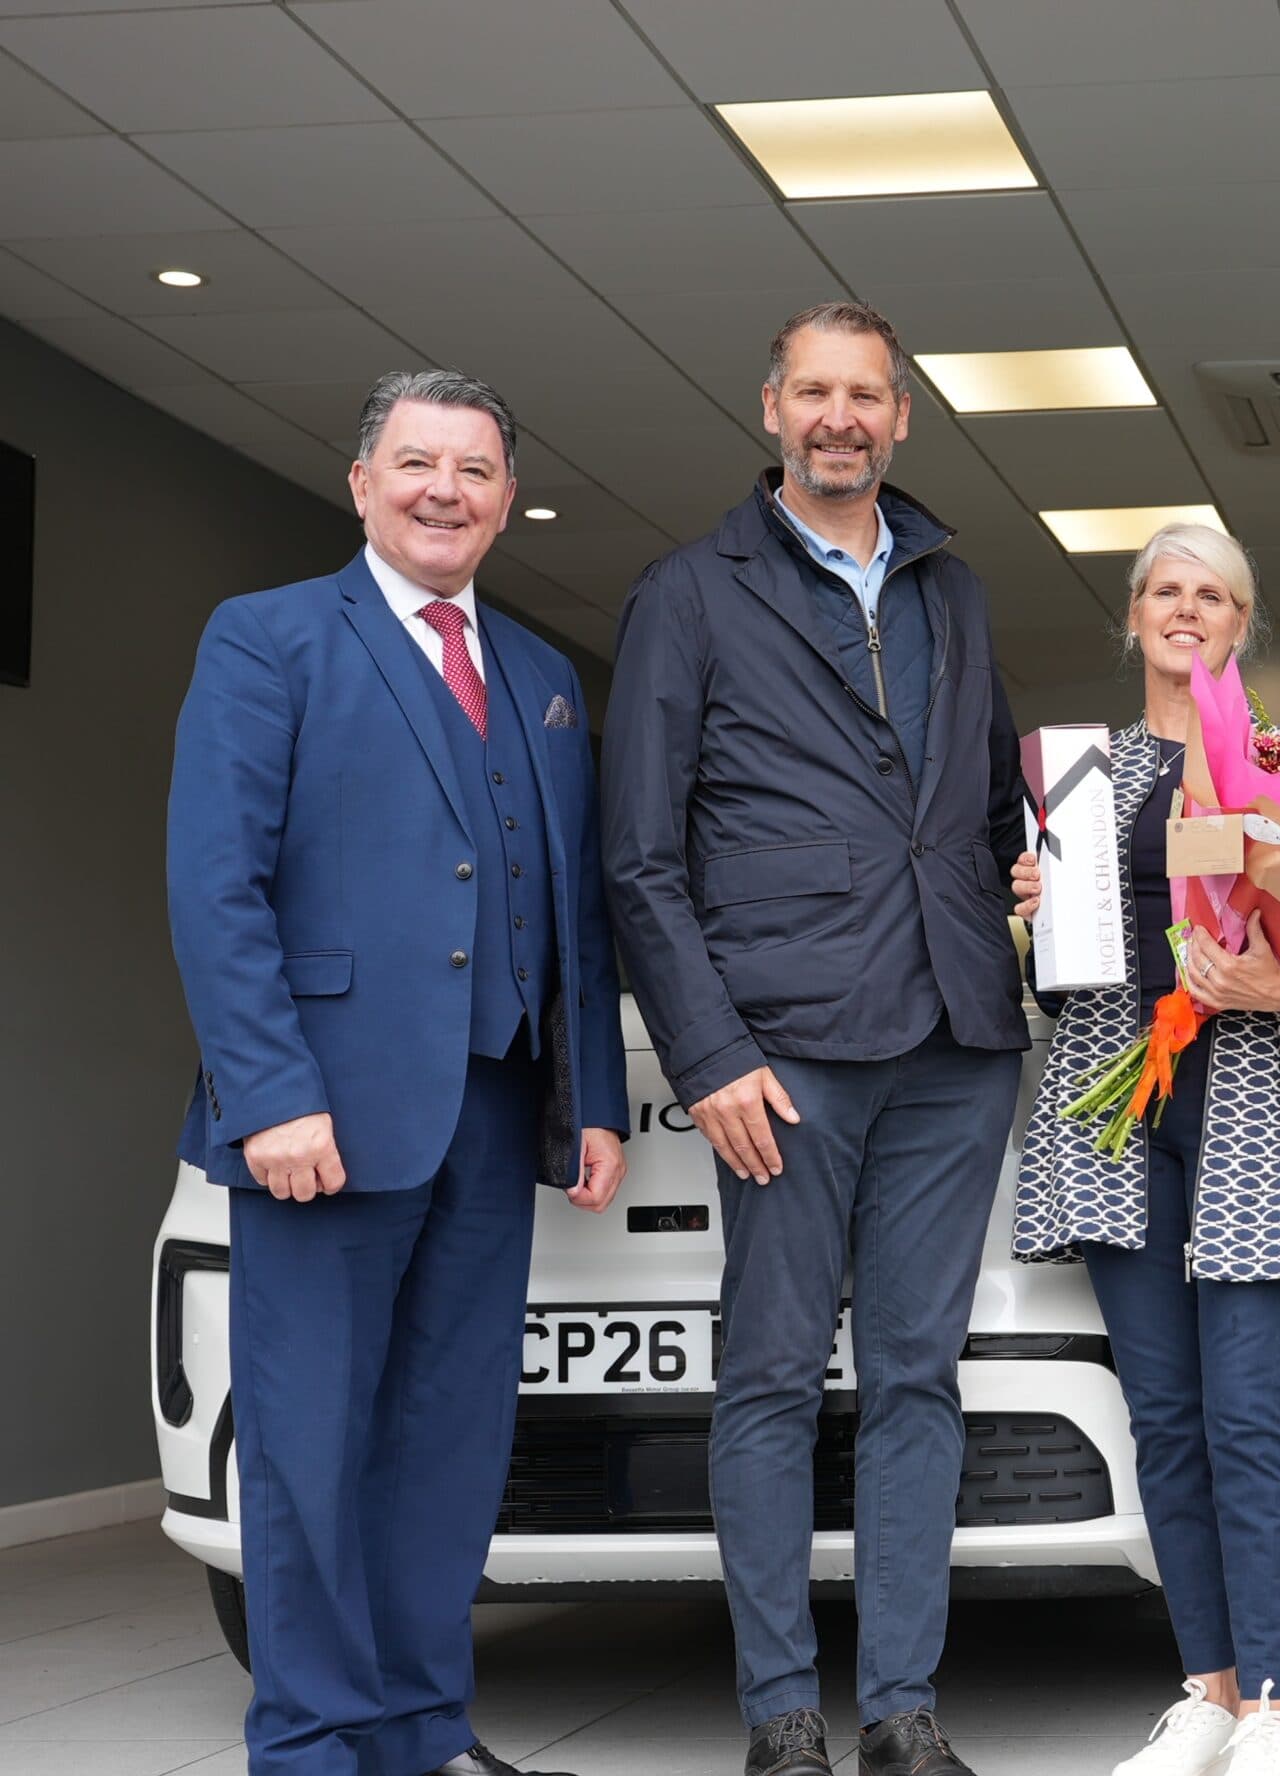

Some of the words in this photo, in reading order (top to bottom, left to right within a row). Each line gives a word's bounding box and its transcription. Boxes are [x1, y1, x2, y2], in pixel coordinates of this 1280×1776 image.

[1089, 788, 1111, 892] CHANDON
[1097, 898, 1113, 912] &
[1096, 918, 1117, 977] MOËT
[520, 1320, 687, 1384] CP26
